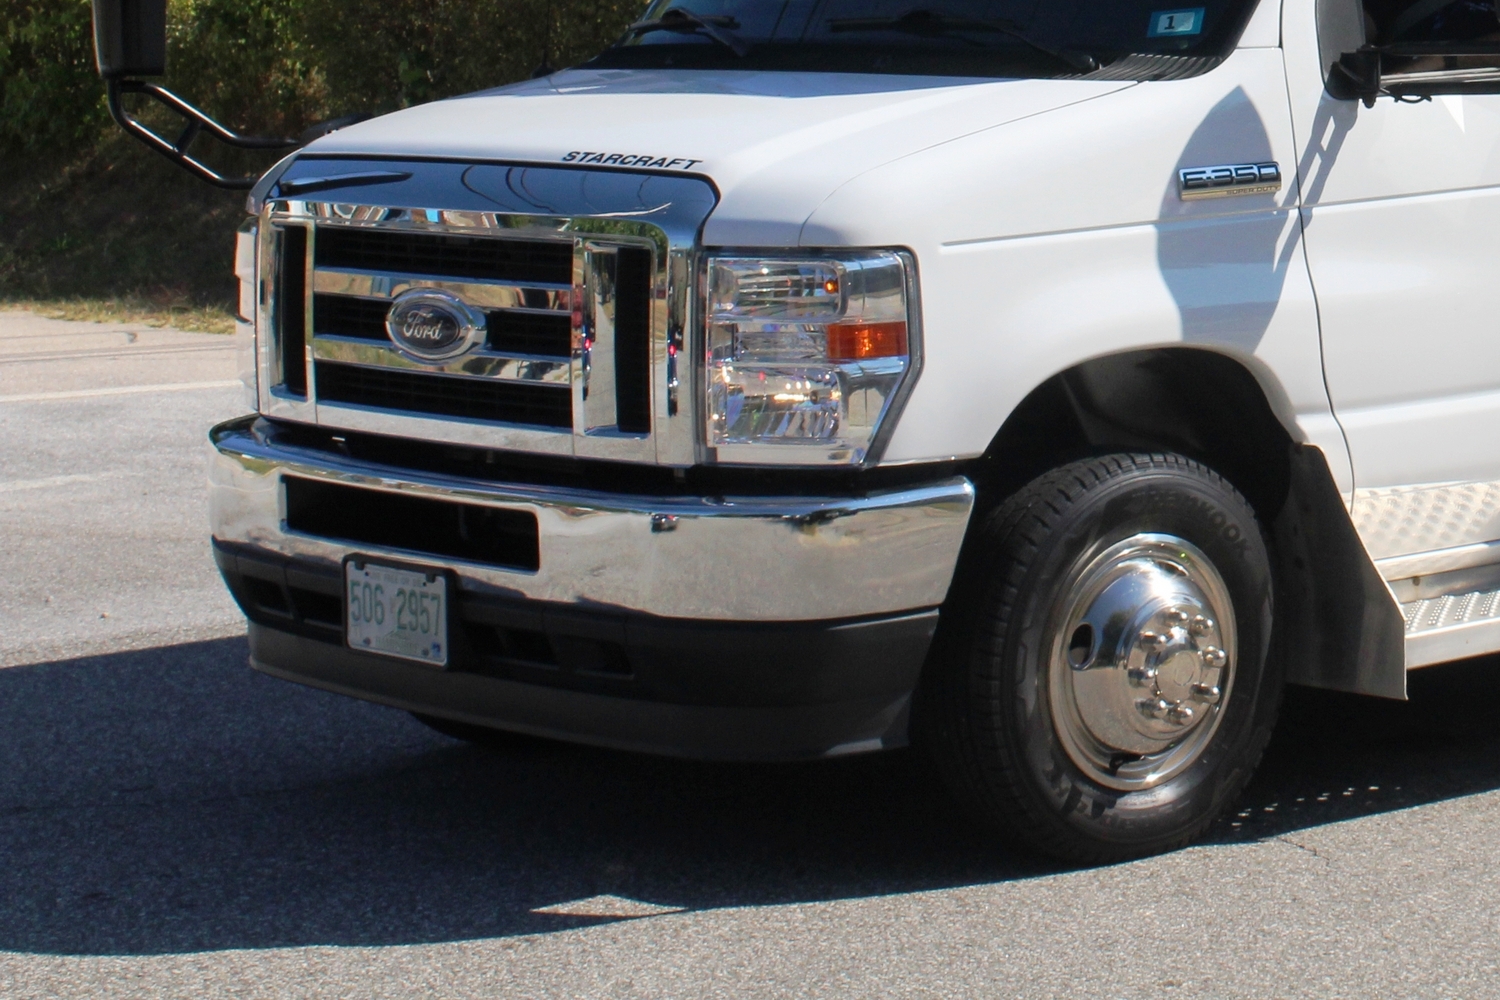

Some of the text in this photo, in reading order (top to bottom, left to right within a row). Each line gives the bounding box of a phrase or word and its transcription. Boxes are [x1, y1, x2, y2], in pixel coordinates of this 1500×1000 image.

[562, 151, 703, 170] STARCRAFT
[1226, 185, 1278, 195] SUPER DUTY
[403, 310, 443, 340] Ford
[350, 580, 441, 637] 506 2957
